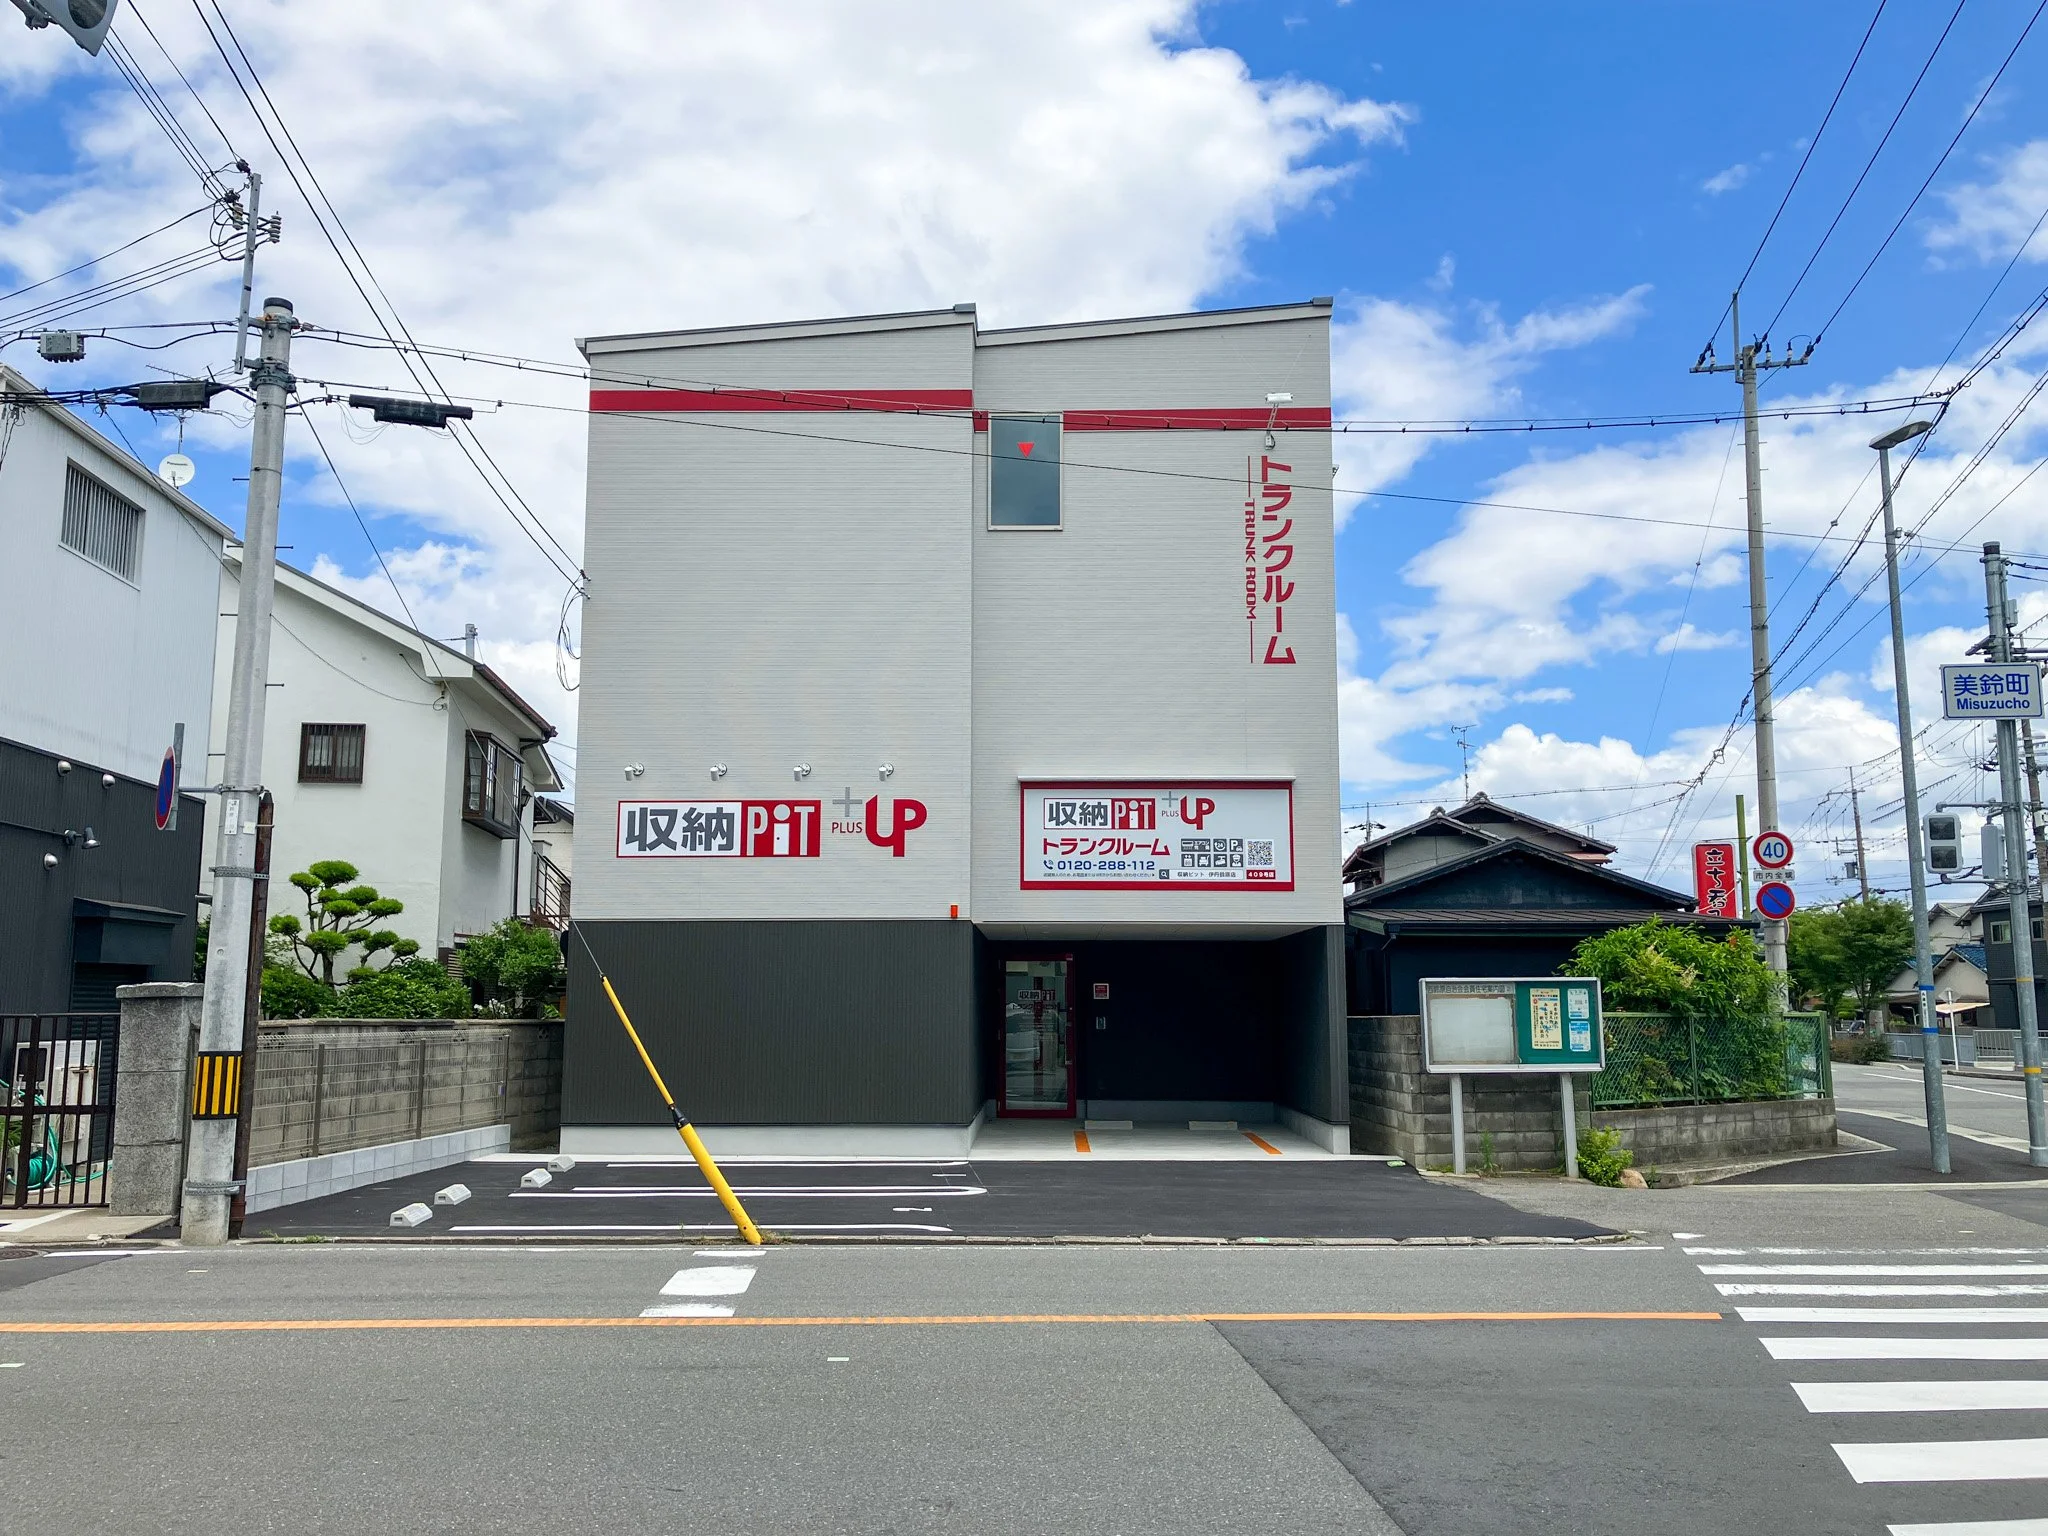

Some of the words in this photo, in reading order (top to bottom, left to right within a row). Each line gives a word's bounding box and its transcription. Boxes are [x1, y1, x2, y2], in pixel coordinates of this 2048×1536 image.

[1244, 498, 1256, 563] TRUNK
[1261, 455, 1296, 664] トランクルーム
[1245, 567, 1257, 620] ROOM
[1953, 673, 2030, 696] 美鈴町
[1956, 697, 2031, 710] Misuzucho
[1048, 801, 1108, 827] 収納
[1161, 810, 1180, 818] PLUS
[1180, 795, 1216, 831] UP
[625, 806, 736, 852] 収納
[831, 821, 863, 834] PLUS
[865, 794, 928, 858] UP
[1043, 837, 1171, 856] トランクルーム
[1762, 842, 1785, 858] 40
[1057, 860, 1155, 870] 0120-288-112
[1755, 871, 1794, 880] 市内全域
